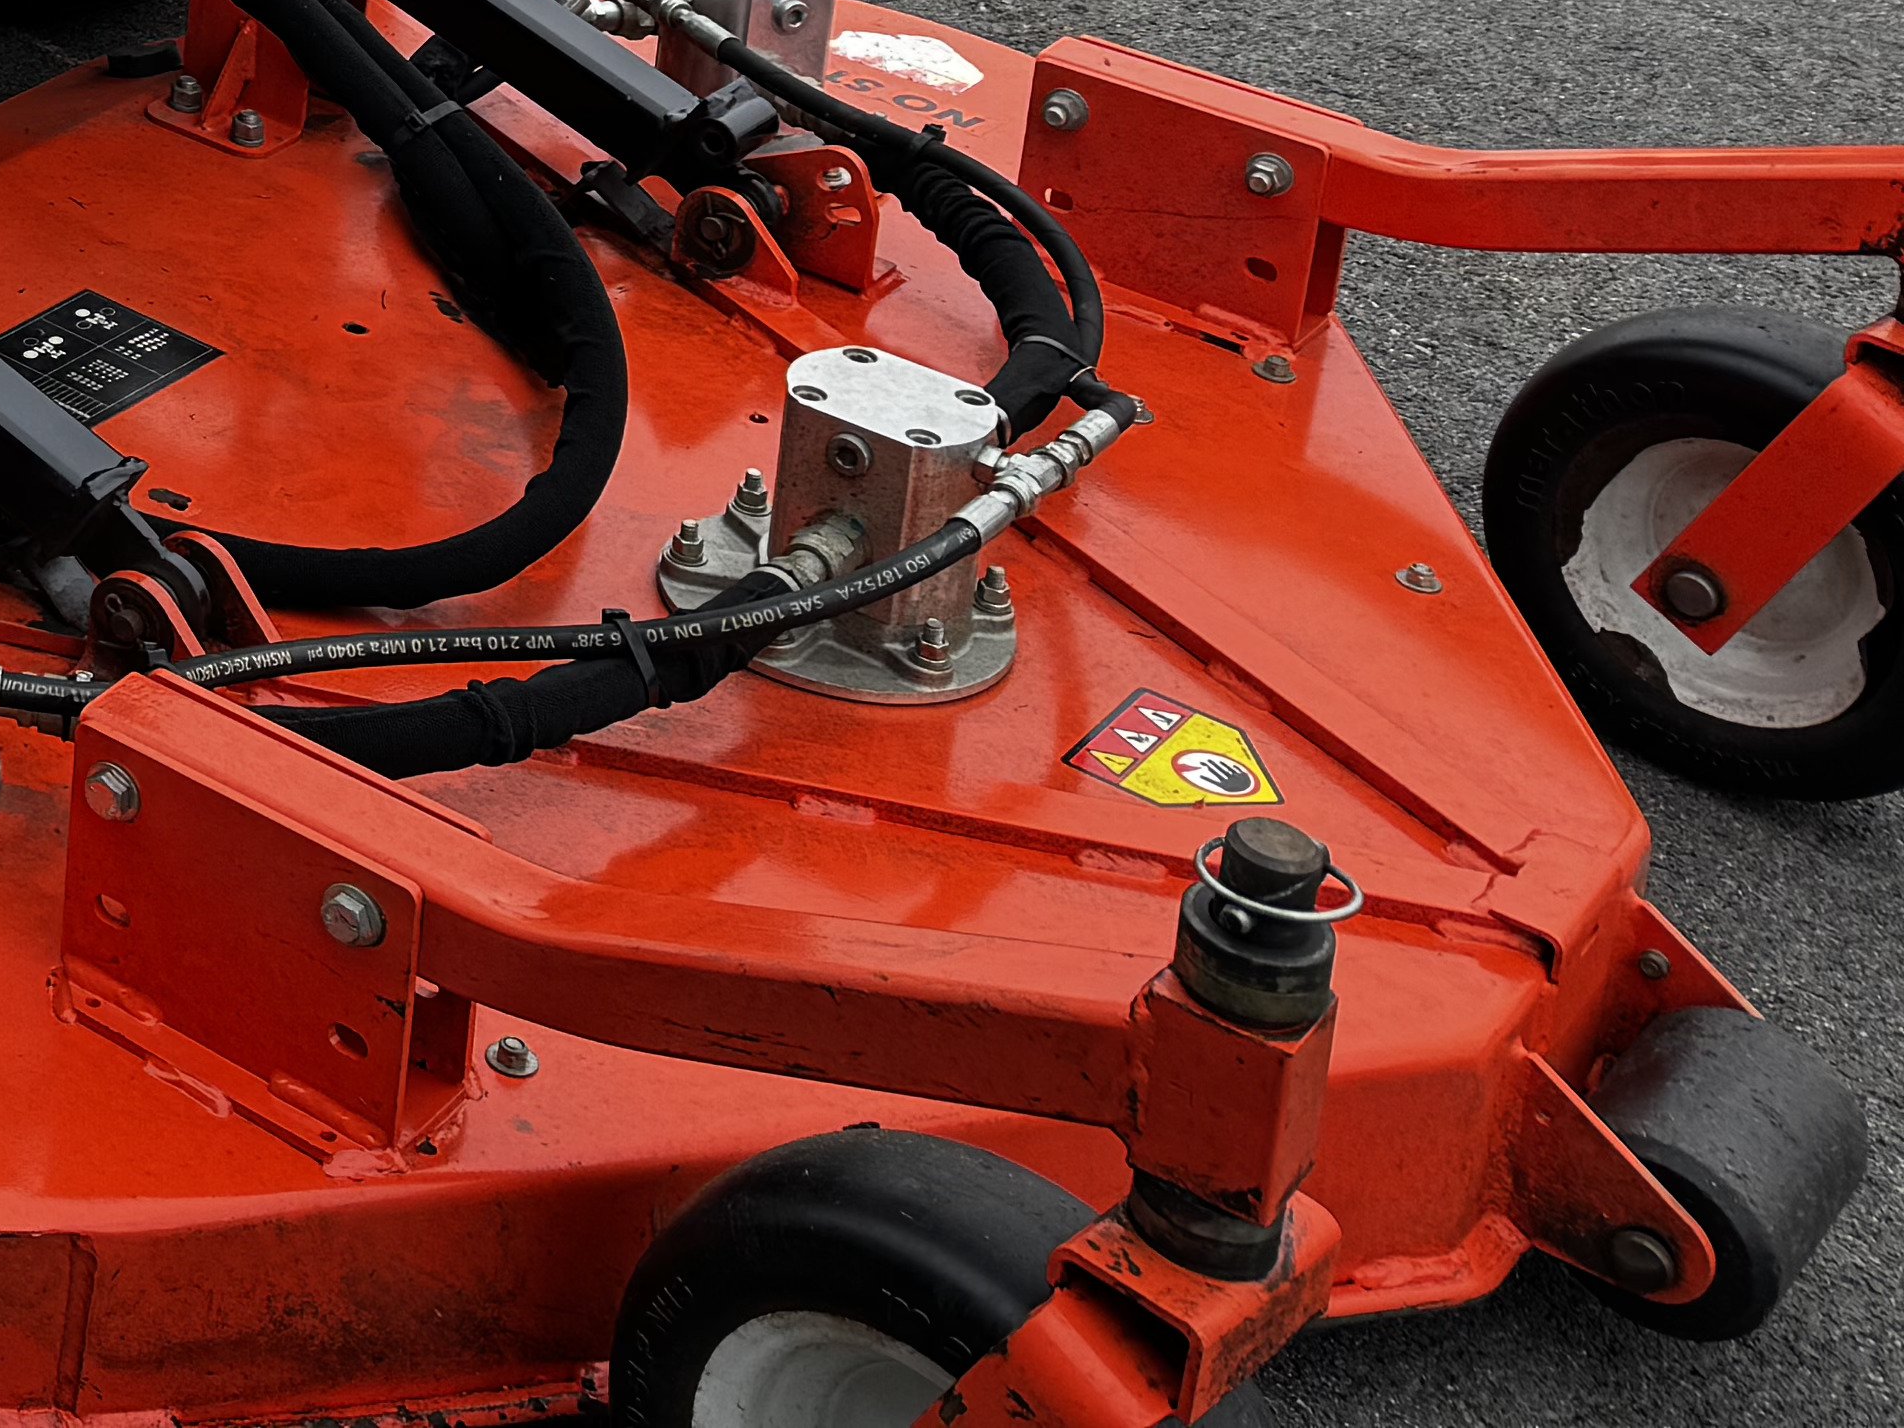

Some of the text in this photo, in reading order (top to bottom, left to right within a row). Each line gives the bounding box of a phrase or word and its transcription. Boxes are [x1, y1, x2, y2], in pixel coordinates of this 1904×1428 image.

[893, 94, 985, 128] NO
[904, 551, 932, 572] ISO
[789, 593, 825, 615] SAE
[720, 605, 785, 633] 100R17
[646, 626, 669, 643] 10
[674, 622, 703, 640] DN
[327, 642, 366, 660] 3040
[371, 639, 407, 657] MPa
[411, 637, 448, 654] 21.0
[453, 636, 482, 653] bar
[487, 634, 520, 651] 210
[525, 634, 556, 650] WP
[251, 649, 292, 671] MSHA
